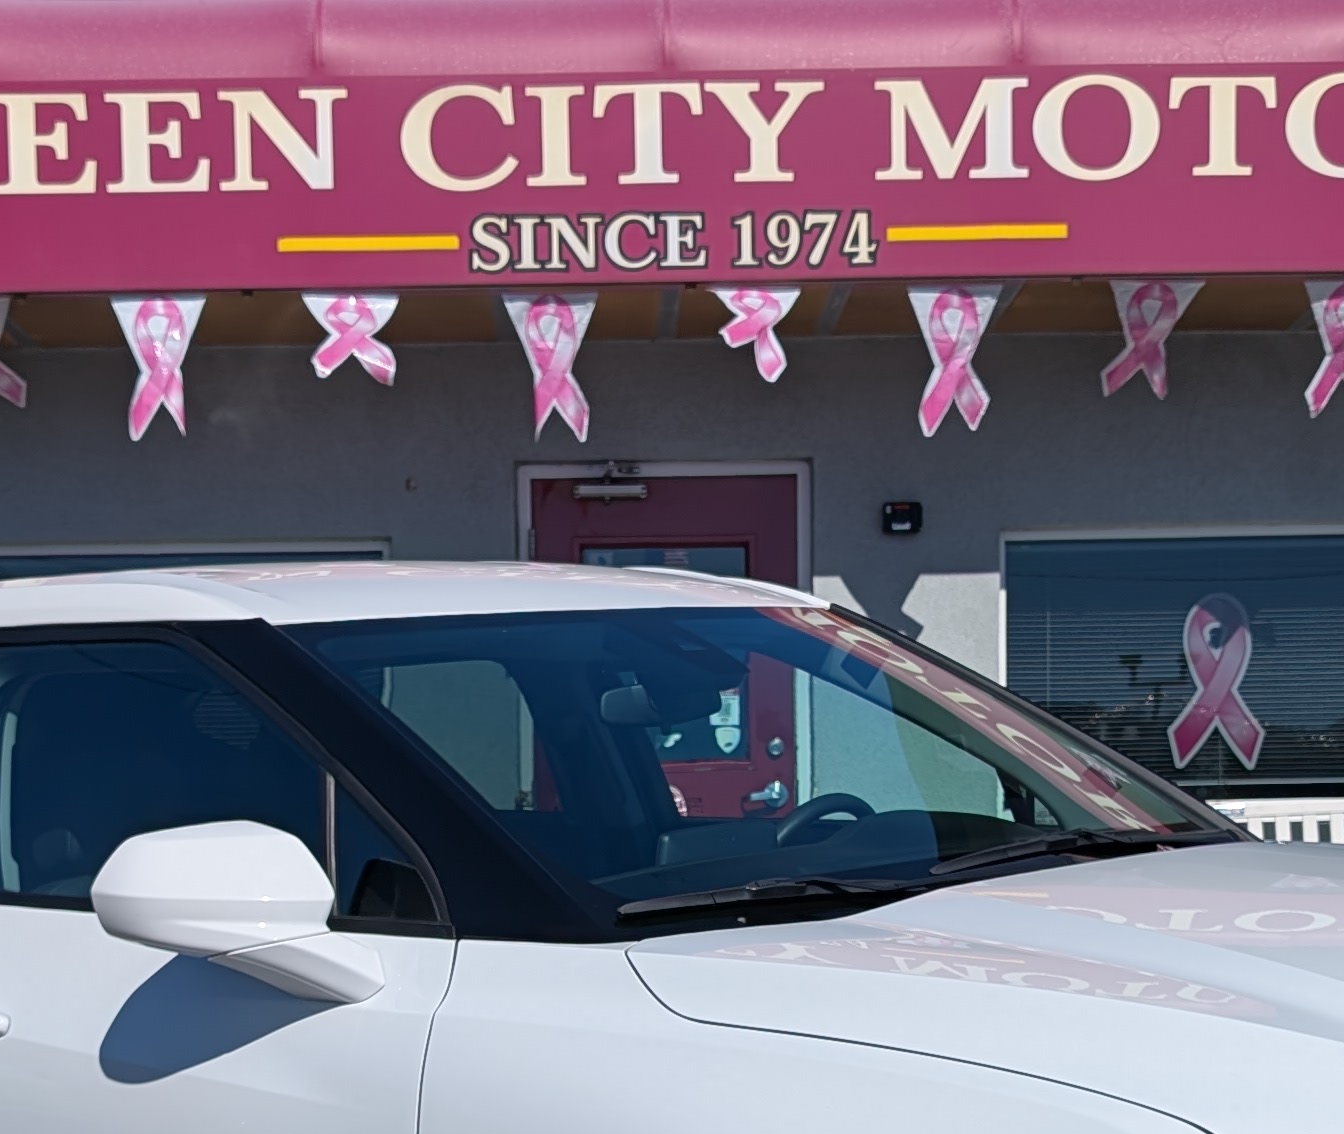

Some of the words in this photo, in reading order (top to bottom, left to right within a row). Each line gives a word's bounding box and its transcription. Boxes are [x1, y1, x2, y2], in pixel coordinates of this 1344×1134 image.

[398, 78, 825, 193] CITY
[468, 212, 709, 275] SINCE
[731, 209, 878, 268] 1974
